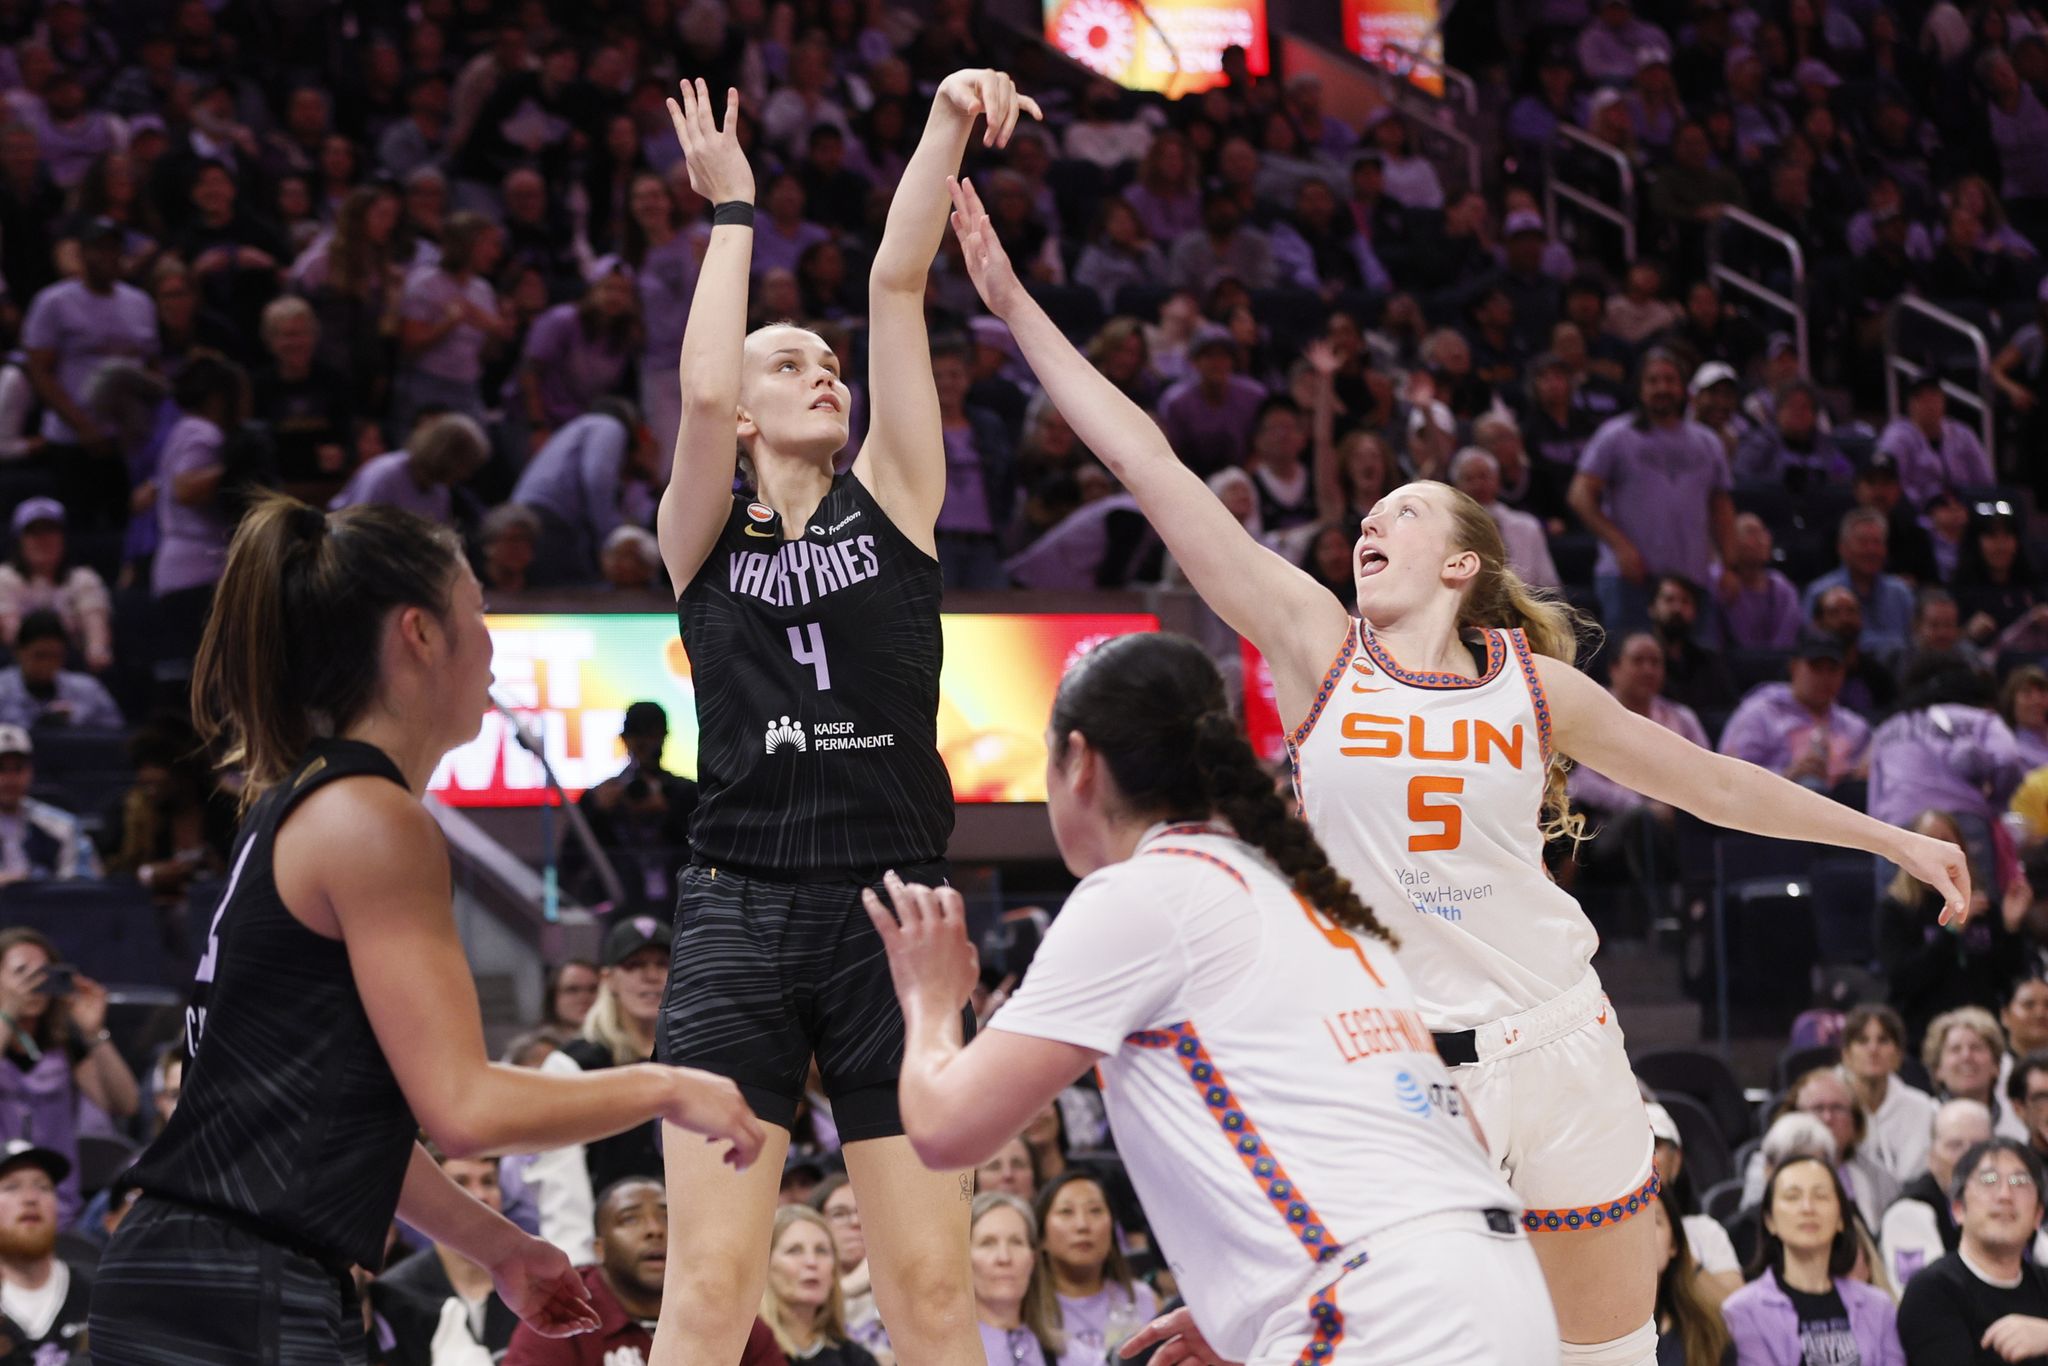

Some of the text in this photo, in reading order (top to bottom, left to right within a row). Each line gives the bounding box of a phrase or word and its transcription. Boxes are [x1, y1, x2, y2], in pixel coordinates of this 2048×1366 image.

[828, 510, 862, 536] freedom
[729, 535, 879, 607] VALKYRIES
[489, 630, 593, 709] ET
[786, 622, 831, 691] 4
[813, 722, 855, 736] KAISER
[815, 734, 895, 751] PERMANENTE
[1340, 712, 1522, 770] SUN
[1407, 775, 1464, 852] 5
[1395, 868, 1431, 885] Yale
[1412, 901, 1462, 921] Hlth
